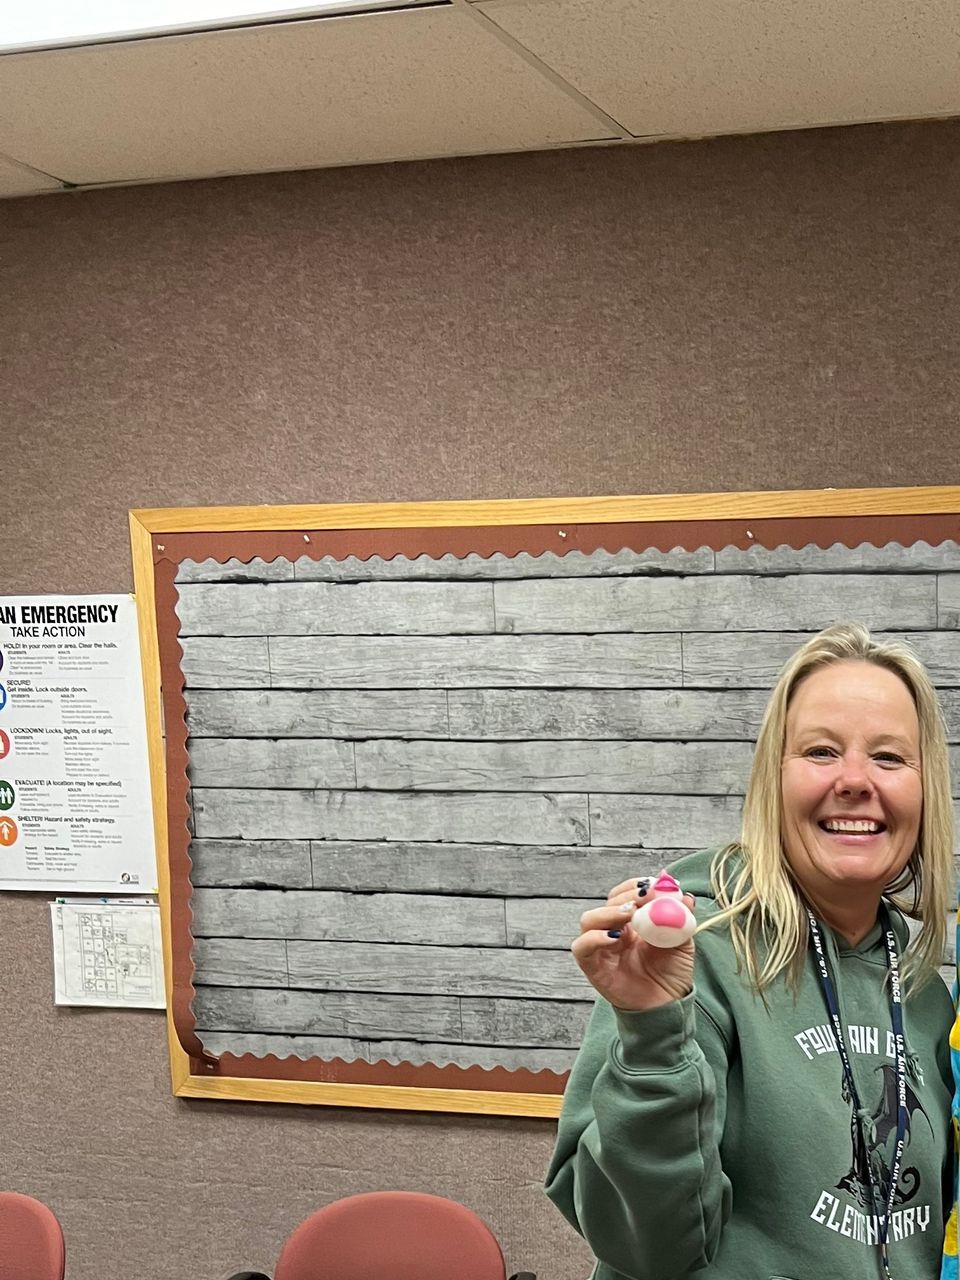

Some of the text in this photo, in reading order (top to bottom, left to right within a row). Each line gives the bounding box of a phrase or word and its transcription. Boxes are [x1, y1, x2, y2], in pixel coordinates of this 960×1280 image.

[21, 605, 118, 624] EMERGENCY
[10, 626, 85, 637] TAKE ACTION
[886, 931, 900, 1003] U.S. AIR FORCE
[899, 1076, 907, 1107] FORCE
